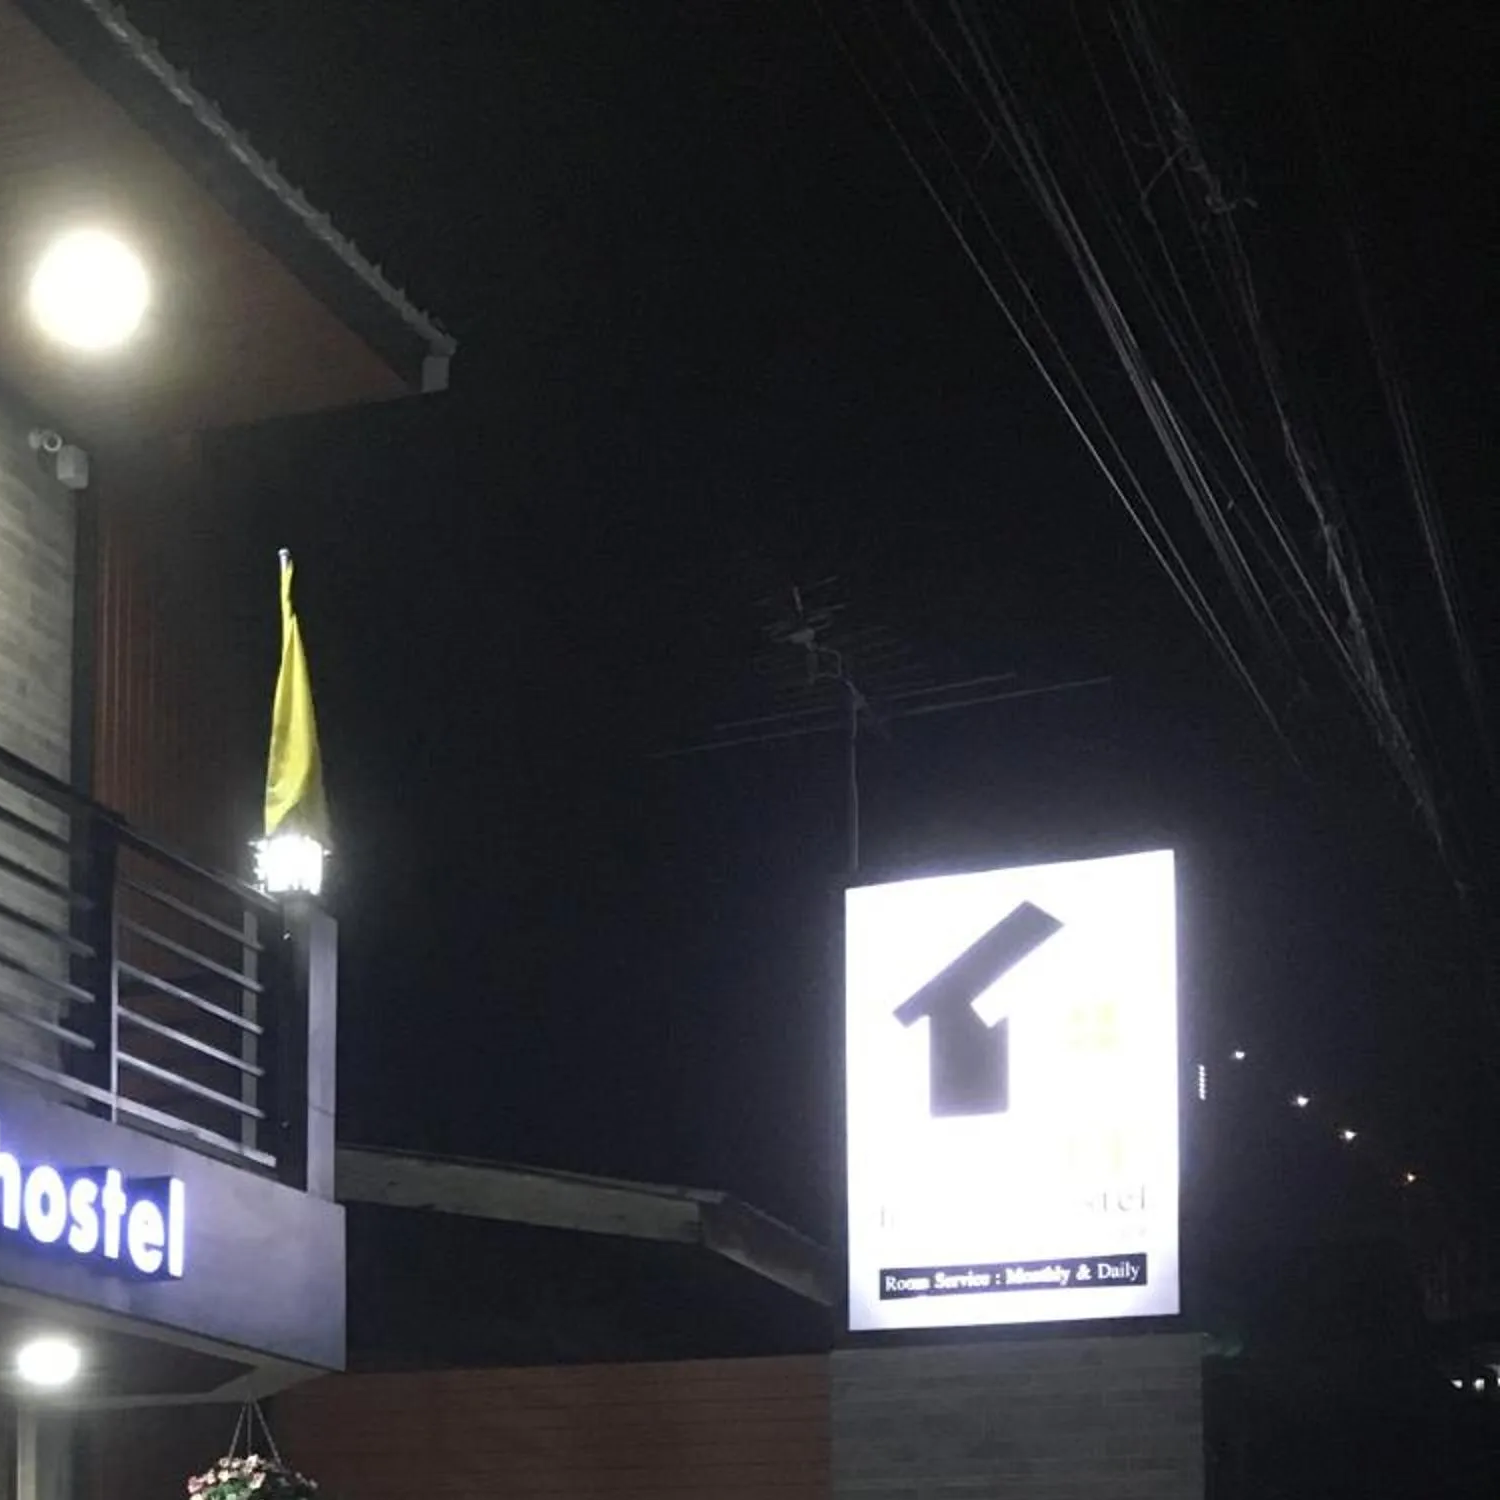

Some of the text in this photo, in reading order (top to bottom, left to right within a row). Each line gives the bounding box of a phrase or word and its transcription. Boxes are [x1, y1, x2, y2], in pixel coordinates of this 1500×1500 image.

[885, 1275, 930, 1293] Room
[934, 1271, 991, 1290] Service
[1076, 1263, 1092, 1281] &
[1097, 1261, 1140, 1282] Daily
